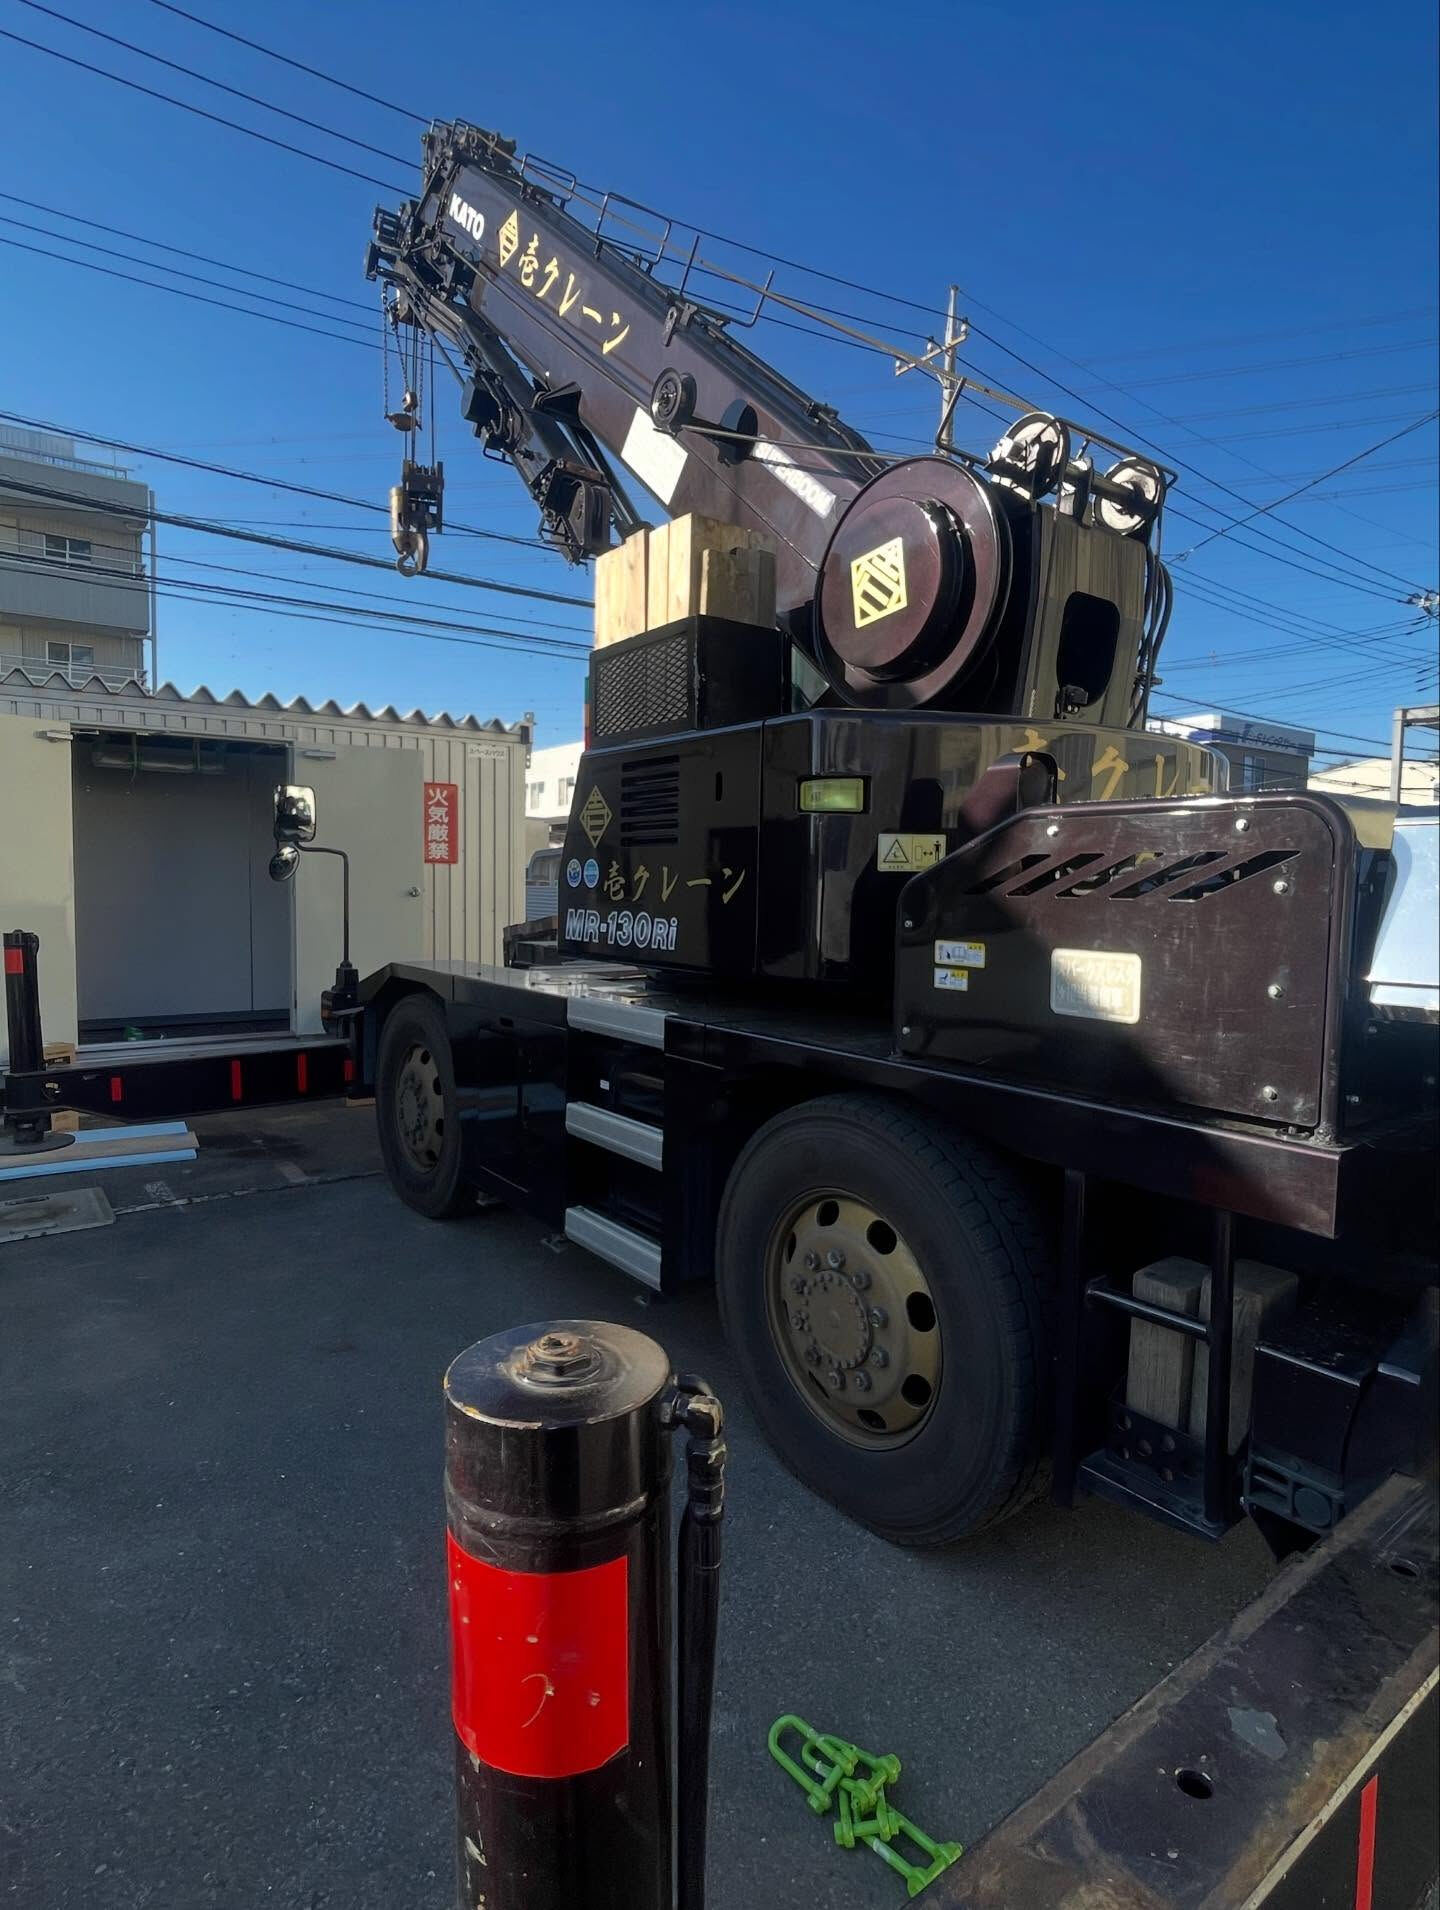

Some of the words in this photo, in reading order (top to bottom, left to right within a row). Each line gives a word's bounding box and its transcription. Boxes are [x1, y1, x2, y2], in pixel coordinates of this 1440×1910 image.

[449, 192, 485, 241] KATO
[427, 787, 449, 860] 火気厳禁
[564, 907, 679, 951] MR-130Ri
